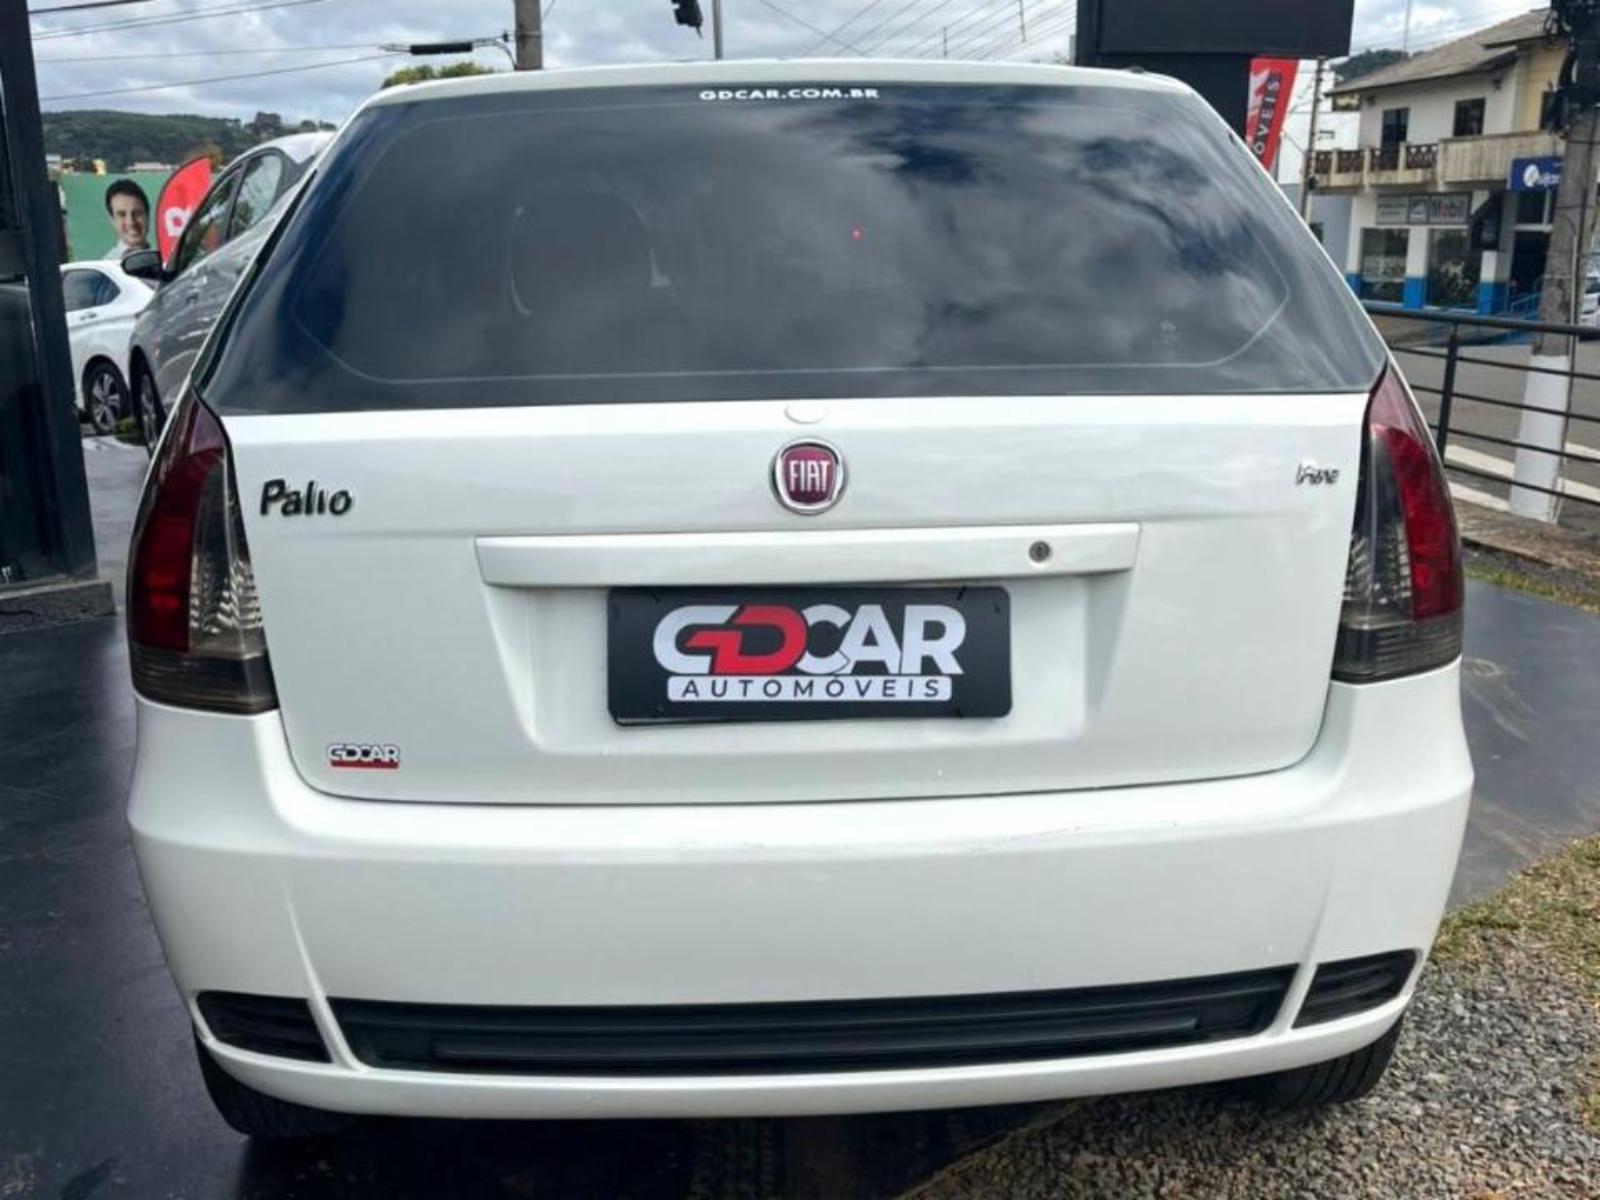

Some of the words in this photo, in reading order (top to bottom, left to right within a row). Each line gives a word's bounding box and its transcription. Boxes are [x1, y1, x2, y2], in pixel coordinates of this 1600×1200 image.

[699, 88, 879, 101] GDCAR.COM.BR
[789, 460, 831, 492] FIAT
[260, 478, 353, 517] Palio
[653, 604, 967, 675] GDCAR
[681, 674, 940, 699] AUTOMÓVEIS
[328, 744, 400, 762] GDCAR
